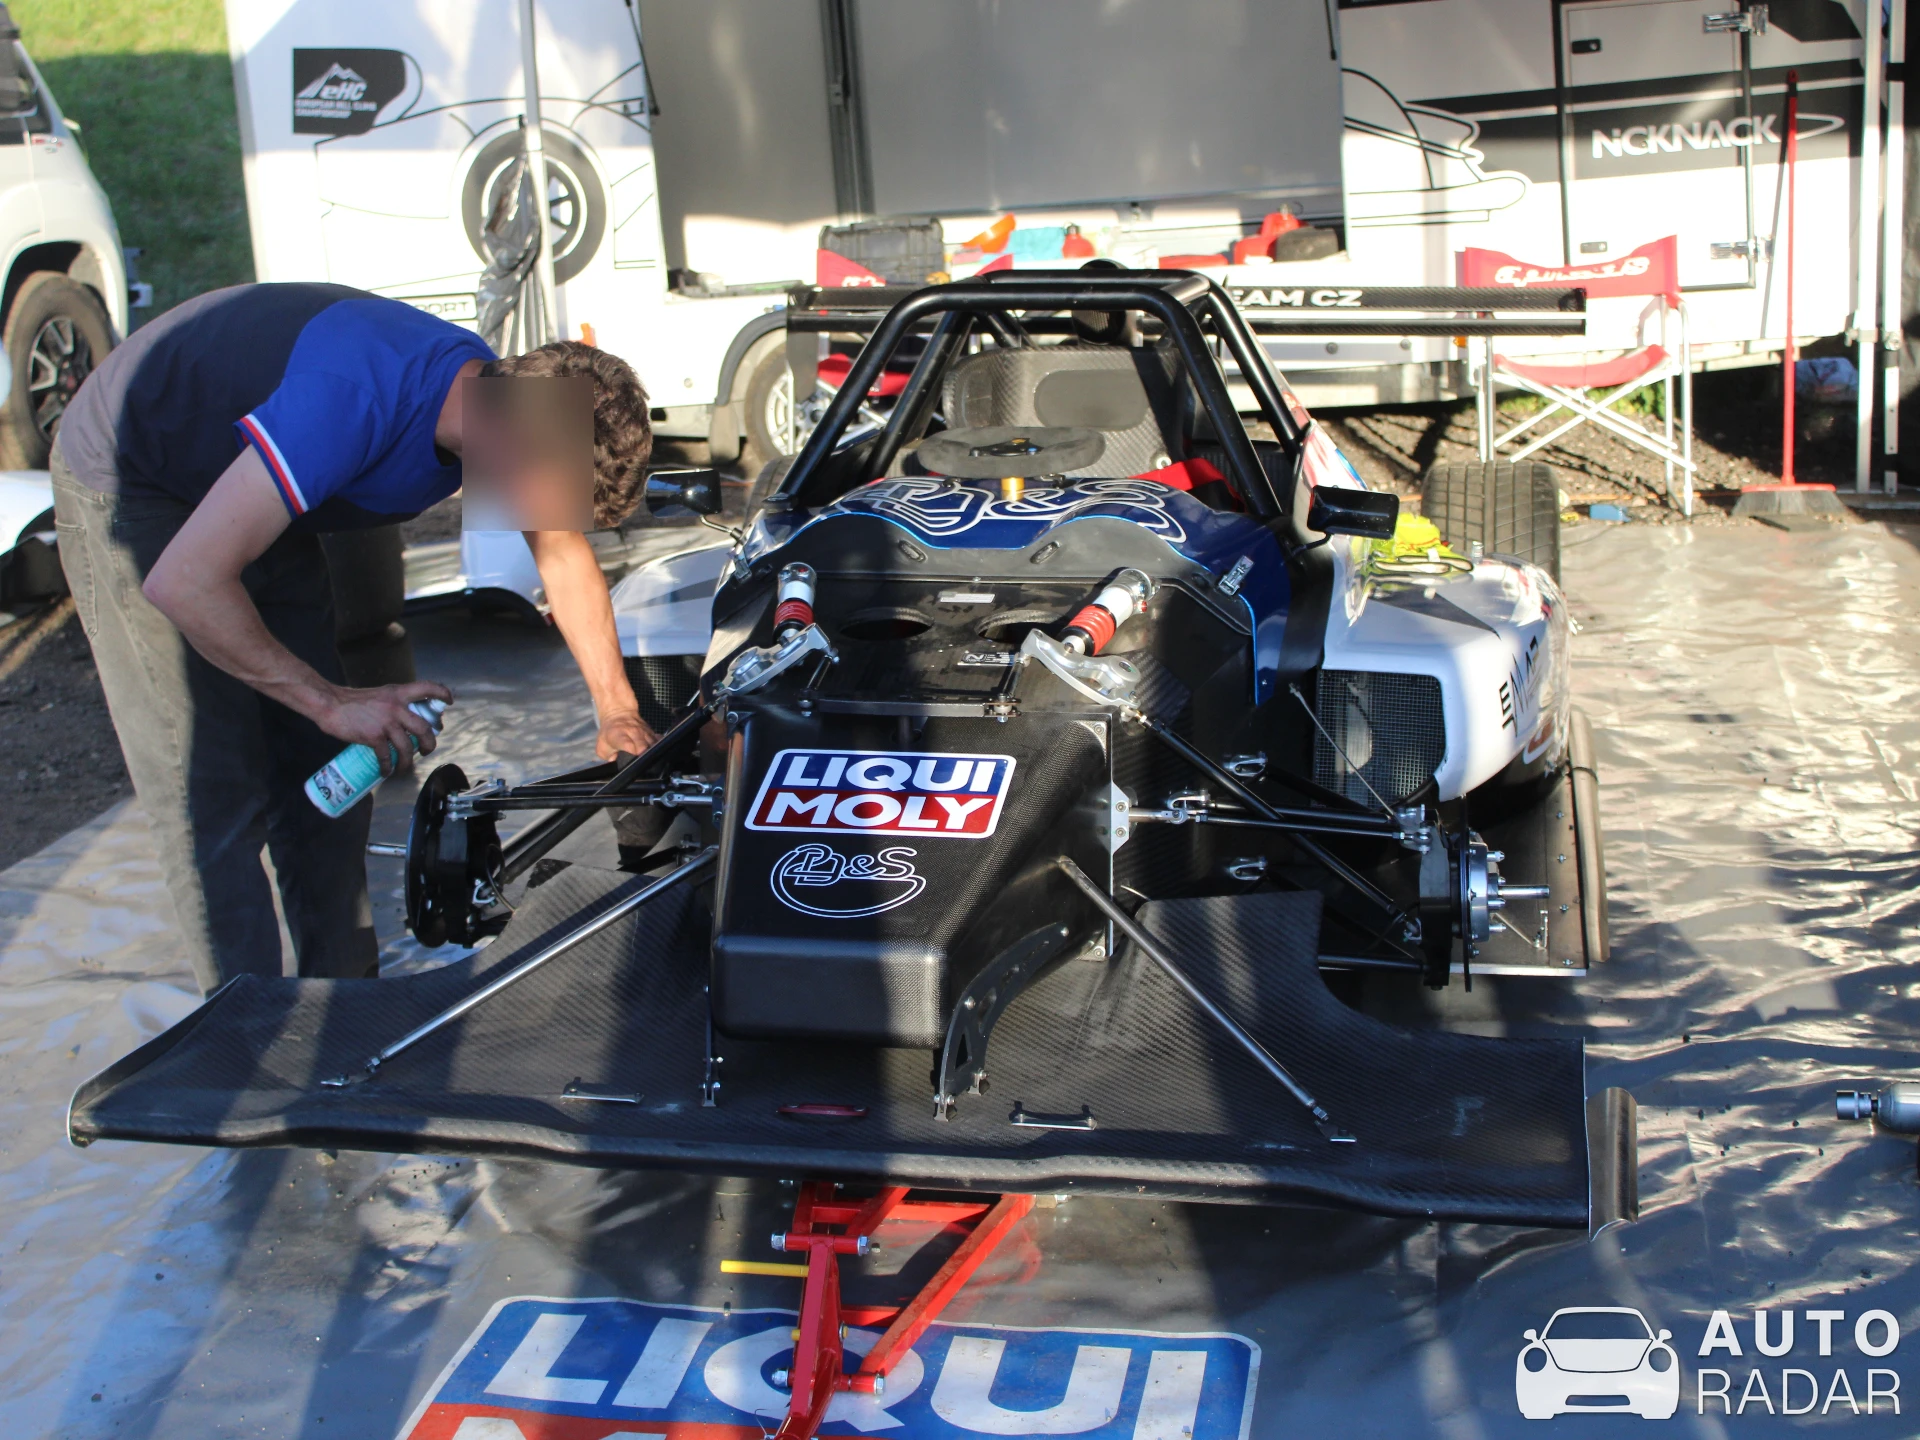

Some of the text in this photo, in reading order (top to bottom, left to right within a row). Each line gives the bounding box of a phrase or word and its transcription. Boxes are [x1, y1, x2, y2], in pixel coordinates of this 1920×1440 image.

[1310, 289, 1363, 307] CZ
[782, 756, 997, 793] LIQUI
[765, 792, 994, 829] MOLY
[484, 1312, 1208, 1440] LIQUI
